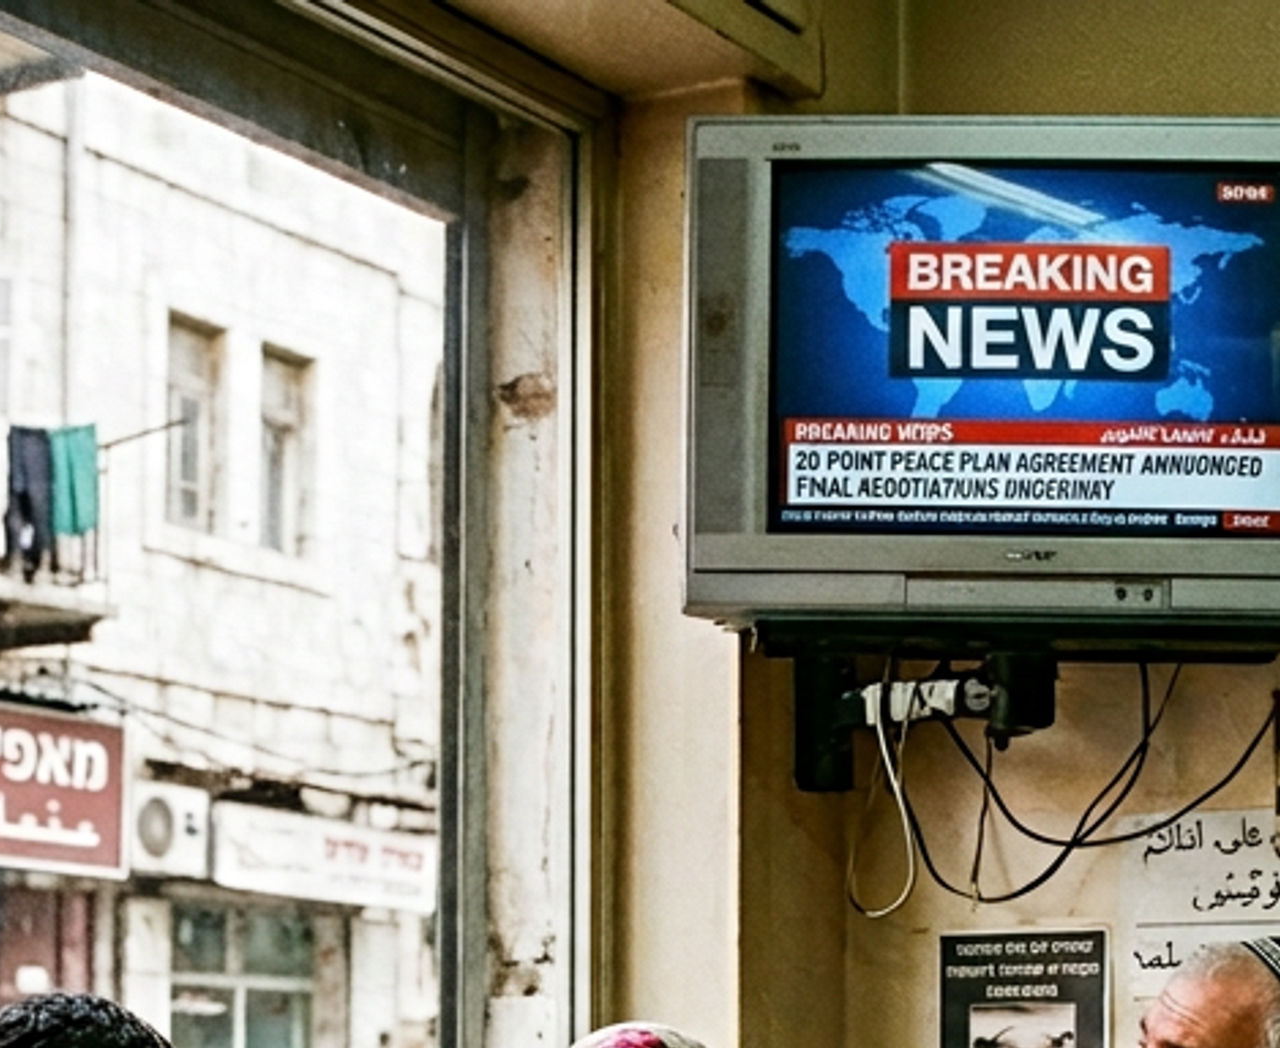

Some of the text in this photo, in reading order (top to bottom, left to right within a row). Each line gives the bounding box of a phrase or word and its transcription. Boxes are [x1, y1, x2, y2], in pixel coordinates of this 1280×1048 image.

[906, 252, 1155, 294] BREAKING
[907, 305, 1156, 372] NEWS
[795, 450, 821, 471] 20
[827, 450, 886, 472] POINT
[890, 451, 955, 473] PEACE
[959, 452, 1013, 473] PLAN
[1015, 452, 1136, 475] AGREEMENT
